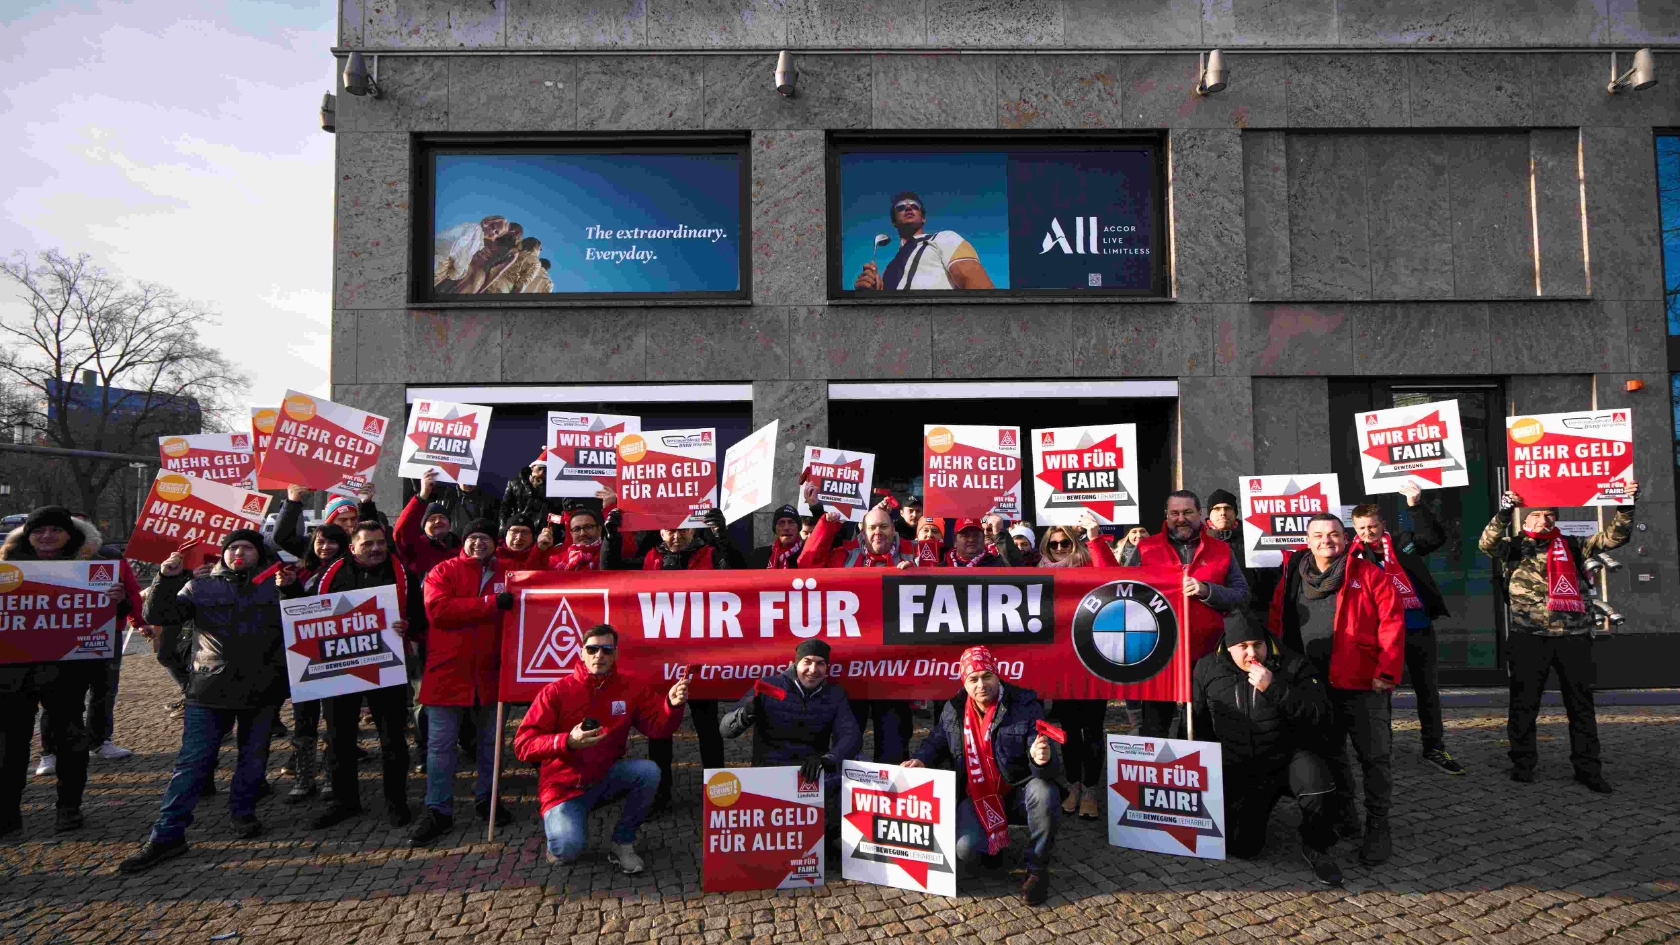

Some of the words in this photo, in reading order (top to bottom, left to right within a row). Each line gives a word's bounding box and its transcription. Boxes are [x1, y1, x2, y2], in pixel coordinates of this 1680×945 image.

[585, 224, 613, 239] The
[616, 224, 727, 243] extraordinary.
[585, 245, 657, 264] Everyday.
[280, 419, 331, 445] MEHR
[334, 434, 376, 456] GELD
[417, 419, 444, 434] WIR
[445, 422, 472, 437] FÜR
[1370, 430, 1404, 446] WIR
[1407, 423, 1441, 441] FÜR
[429, 436, 468, 453] FAIR!
[560, 433, 591, 447] WIR
[594, 432, 617, 448] FÜ
[274, 435, 309, 457] FÜR
[311, 447, 359, 470] ALLE!
[579, 450, 617, 465] FAIR
[1045, 454, 1079, 469] WIR
[1083, 448, 1116, 468] FÜR
[1392, 441, 1441, 461] FAIR!
[1514, 444, 1570, 461] MEHR
[1575, 441, 1626, 458] GELD
[167, 456, 210, 469] MEHR
[213, 454, 250, 466] GELD
[621, 463, 667, 480] MEHR
[671, 461, 711, 478] GELD
[929, 455, 973, 470] MEHR
[977, 456, 1016, 471] GELD
[1515, 460, 1551, 479] FÜR
[1557, 461, 1610, 477] ALLE!
[202, 467, 240, 480] ALLE!
[811, 465, 834, 478] WIR
[836, 467, 859, 481] FÜR
[929, 470, 958, 488] FÜR
[962, 474, 1004, 489] ALLE!
[1067, 471, 1115, 489] FAIR!
[622, 480, 651, 500] FÜR
[656, 481, 699, 498] ALLE!
[823, 480, 856, 495] FAIR!
[1253, 499, 1286, 514] WIR
[1290, 495, 1322, 513] FÜR
[149, 500, 206, 524] MEHR
[209, 514, 255, 531] GELD
[1275, 516, 1312, 532] FAI
[142, 516, 181, 538] FÜR
[183, 527, 226, 547] ALLE
[0, 594, 50, 611] EHR
[56, 593, 111, 609] GELD
[637, 591, 743, 639] WIR
[759, 577, 861, 637] FÜR
[898, 583, 1043, 633] FAIR!
[1083, 583, 1168, 615] BMW
[0, 611, 26, 631] ÜR
[33, 612, 92, 630] ALLE!
[298, 620, 338, 640] WIR
[341, 612, 379, 633] FÜR
[324, 633, 379, 658] FAIR!
[848, 659, 910, 677] BMW
[913, 658, 1024, 680] Dingng
[1121, 764, 1158, 784] WIR
[1162, 764, 1199, 788] FÜR
[855, 792, 891, 815] WIR
[896, 795, 932, 820] FÜR
[1144, 787, 1198, 812] FAIR!
[709, 808, 765, 829] MEHR
[771, 806, 818, 827] GELD
[1129, 811, 1177, 823] TARIFBEWEGUNG
[710, 829, 746, 853] FÜR
[751, 831, 803, 851] ALLE!
[877, 819, 930, 846] FAIR!
[797, 866, 815, 874] FAIR!
[804, 857, 816, 865] FÜR
